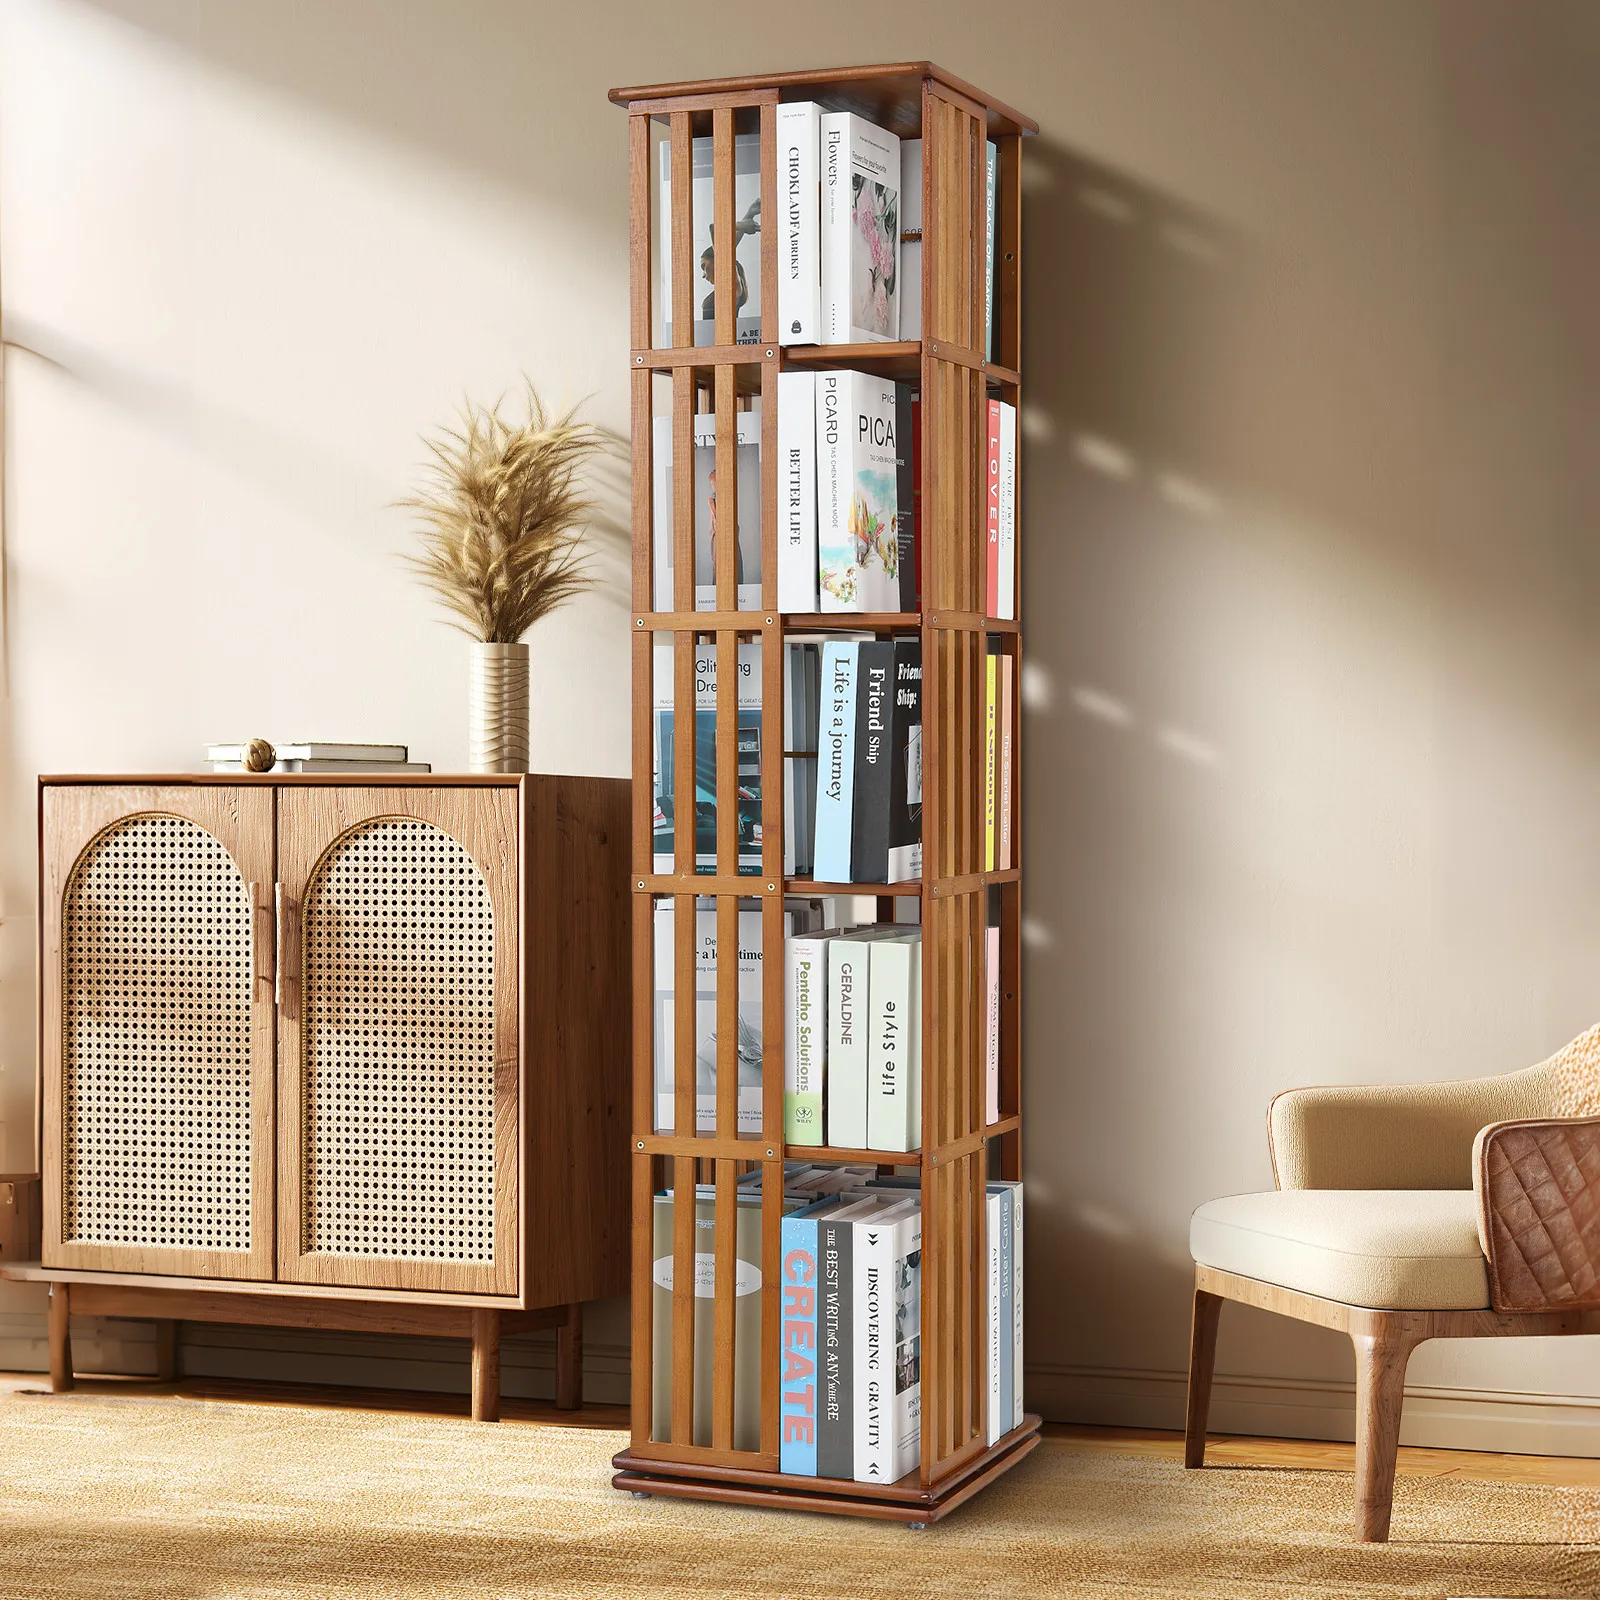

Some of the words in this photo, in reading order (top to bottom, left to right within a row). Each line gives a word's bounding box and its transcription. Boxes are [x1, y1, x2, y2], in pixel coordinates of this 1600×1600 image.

[828, 131, 840, 186] Flowers
[789, 147, 800, 280] CHOKLADFABRIKEN
[986, 244, 992, 263] OF
[825, 378, 838, 445] PICARD
[882, 393, 897, 405] PIC
[790, 449, 800, 508] BETTER
[990, 437, 998, 543] LOVER
[790, 512, 800, 546] LIFE
[834, 658, 851, 694] Life
[868, 667, 886, 731] Friend
[896, 688, 917, 709] Ship:
[832, 717, 843, 727] a
[833, 699, 849, 712] is
[826, 731, 848, 801] journey
[866, 736, 881, 764] Ship
[702, 951, 709, 960] a
[800, 961, 812, 1022] Pentaho
[841, 963, 852, 1045] GERALDINE
[882, 1001, 899, 1051] Style
[800, 1026, 811, 1092] Solutions
[882, 1061, 896, 1096] Life
[827, 1228, 836, 1247] THE
[1001, 1202, 1009, 1250] Carrie
[826, 1250, 839, 1289] BEST
[1001, 1255, 1009, 1298] Sister
[867, 1268, 880, 1371] IDSCOVERING
[784, 1249, 815, 1445] CREATE
[868, 1381, 880, 1450] GRAVITY
